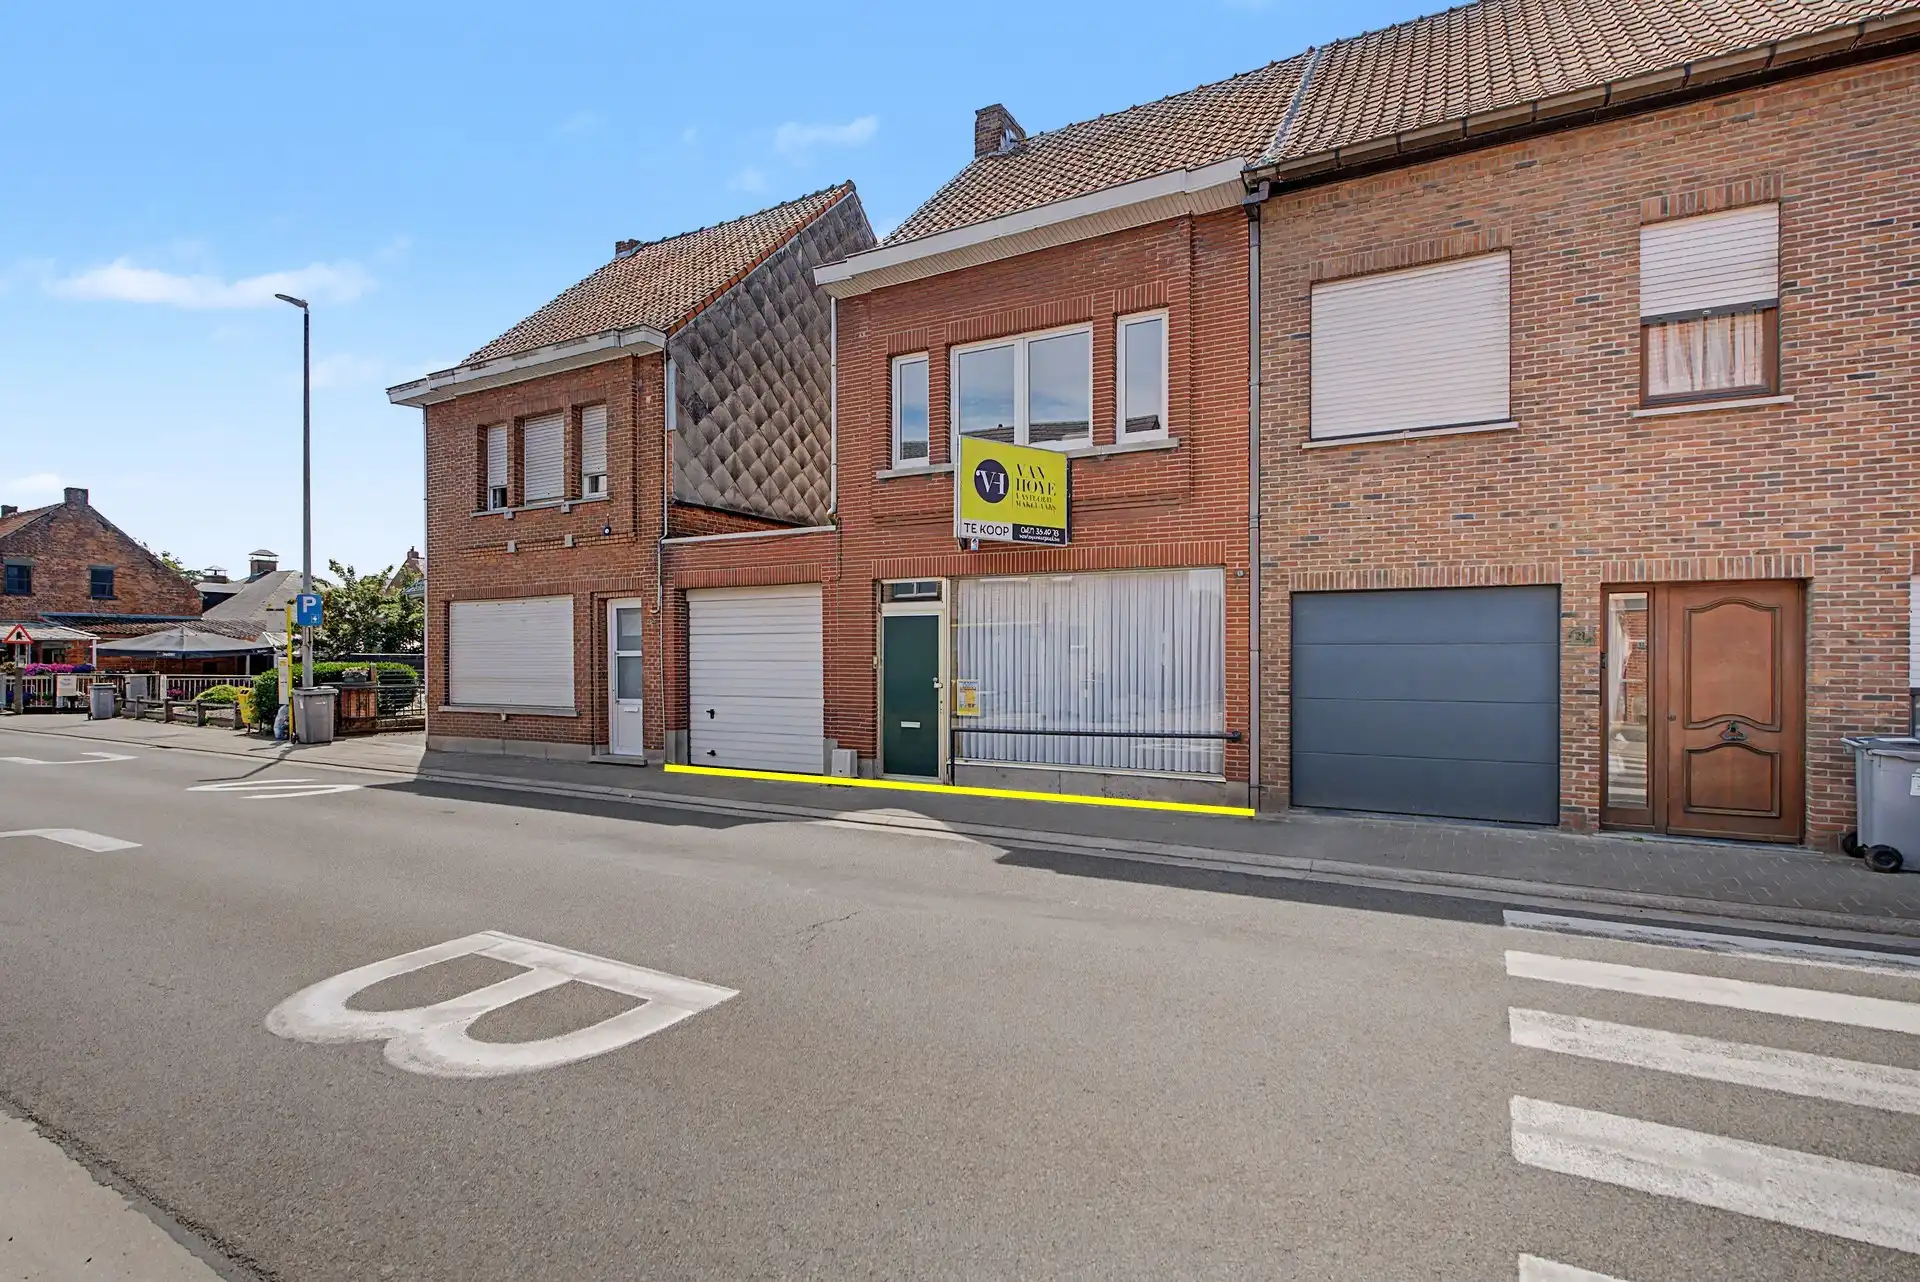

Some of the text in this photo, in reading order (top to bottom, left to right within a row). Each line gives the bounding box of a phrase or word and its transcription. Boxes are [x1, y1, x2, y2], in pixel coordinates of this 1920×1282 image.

[963, 522, 1010, 537] TE KOOP
[302, 596, 317, 613] P
[264, 930, 741, 1078] B
